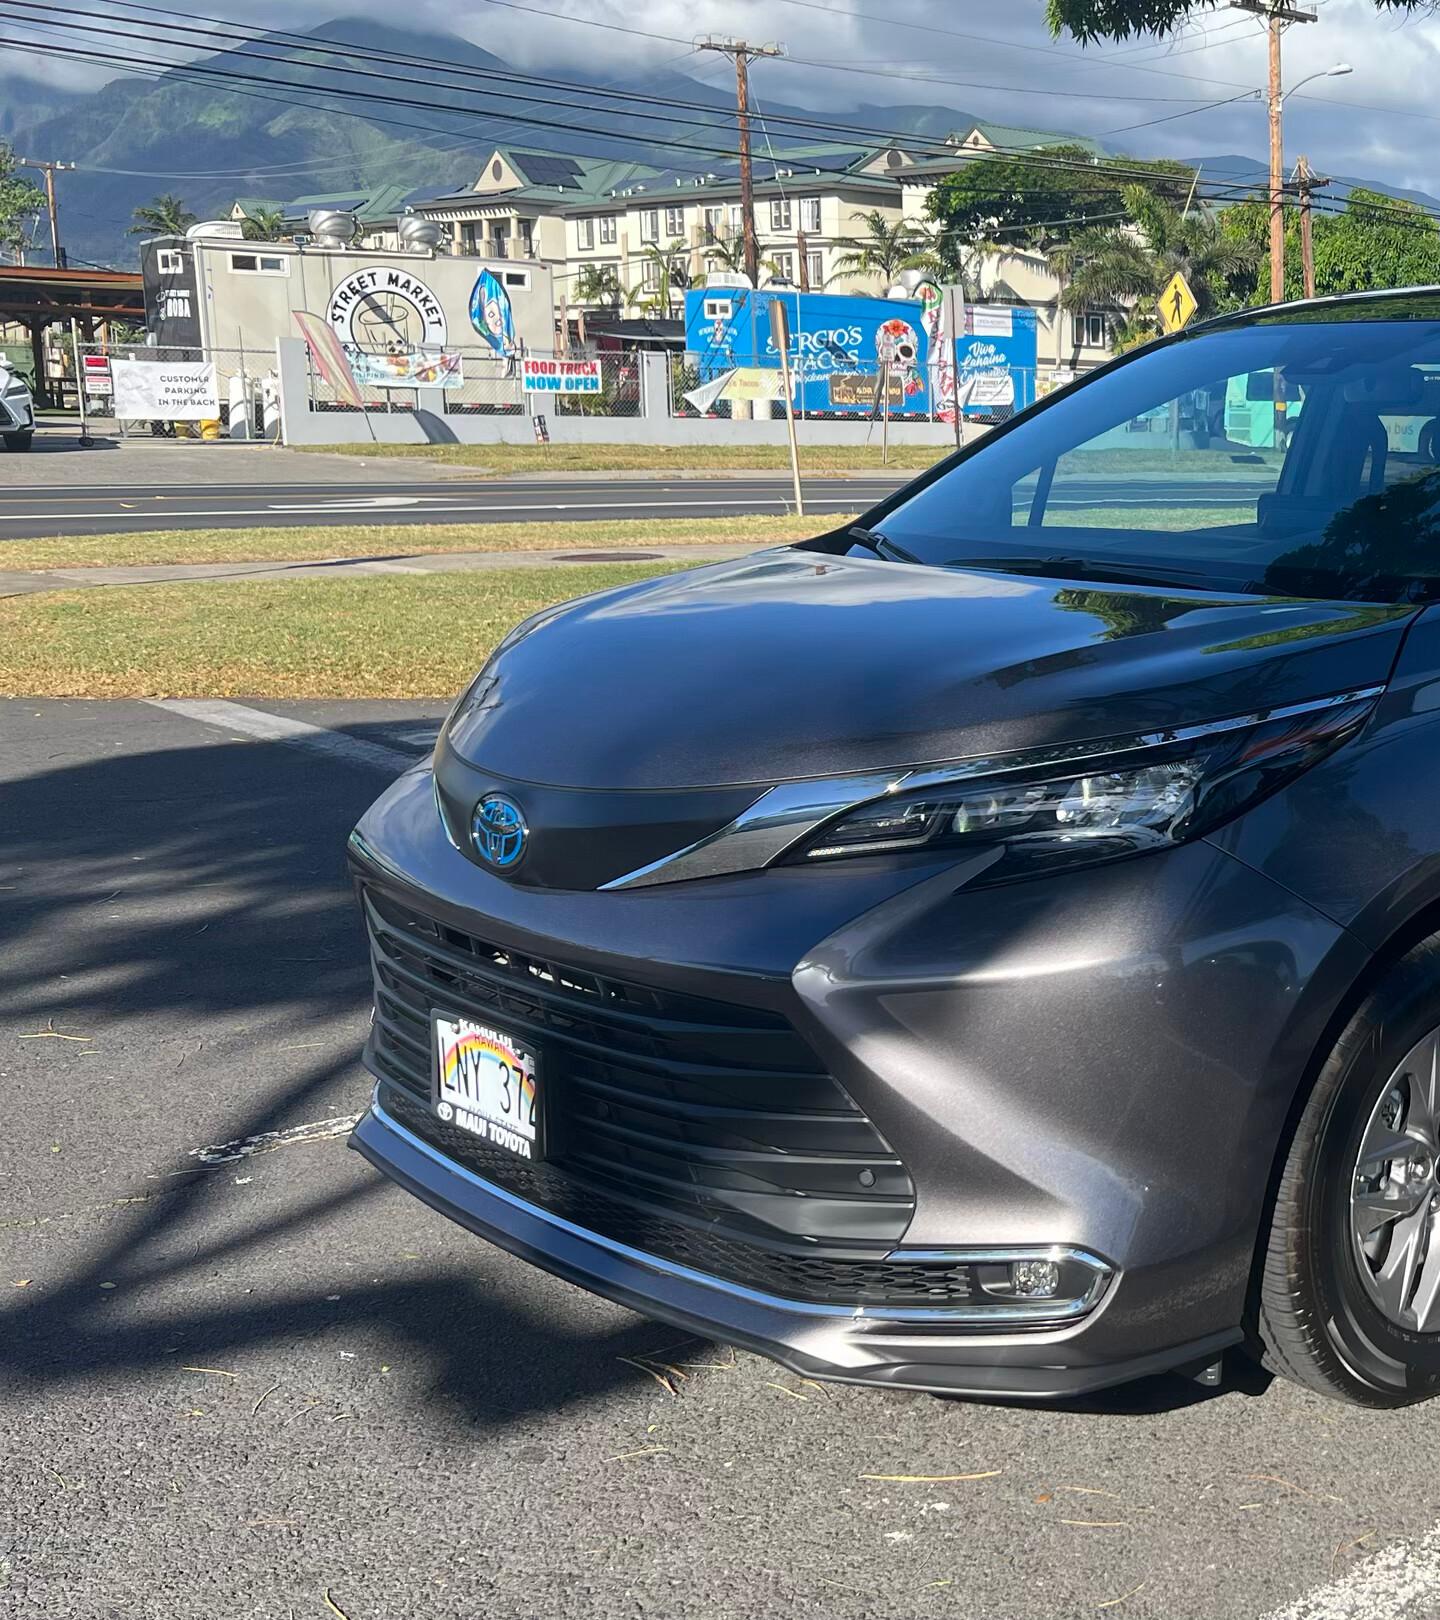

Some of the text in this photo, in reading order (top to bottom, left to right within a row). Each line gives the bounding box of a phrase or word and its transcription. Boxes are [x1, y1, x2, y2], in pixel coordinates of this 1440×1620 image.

[167, 298, 191, 317] BOBA
[331, 272, 443, 328] STREET MARKET
[968, 341, 996, 357] Viva
[524, 361, 598, 376] FOOD TRUCK
[790, 349, 859, 371] TACOS
[960, 352, 1006, 367] Lahaina
[525, 375, 599, 391] NOW OPEN
[458, 1018, 513, 1049] KAHULUI
[474, 1035, 506, 1053] HAWAII
[441, 1036, 482, 1102] LNY
[455, 1108, 532, 1160] MAUI TOYOTA
